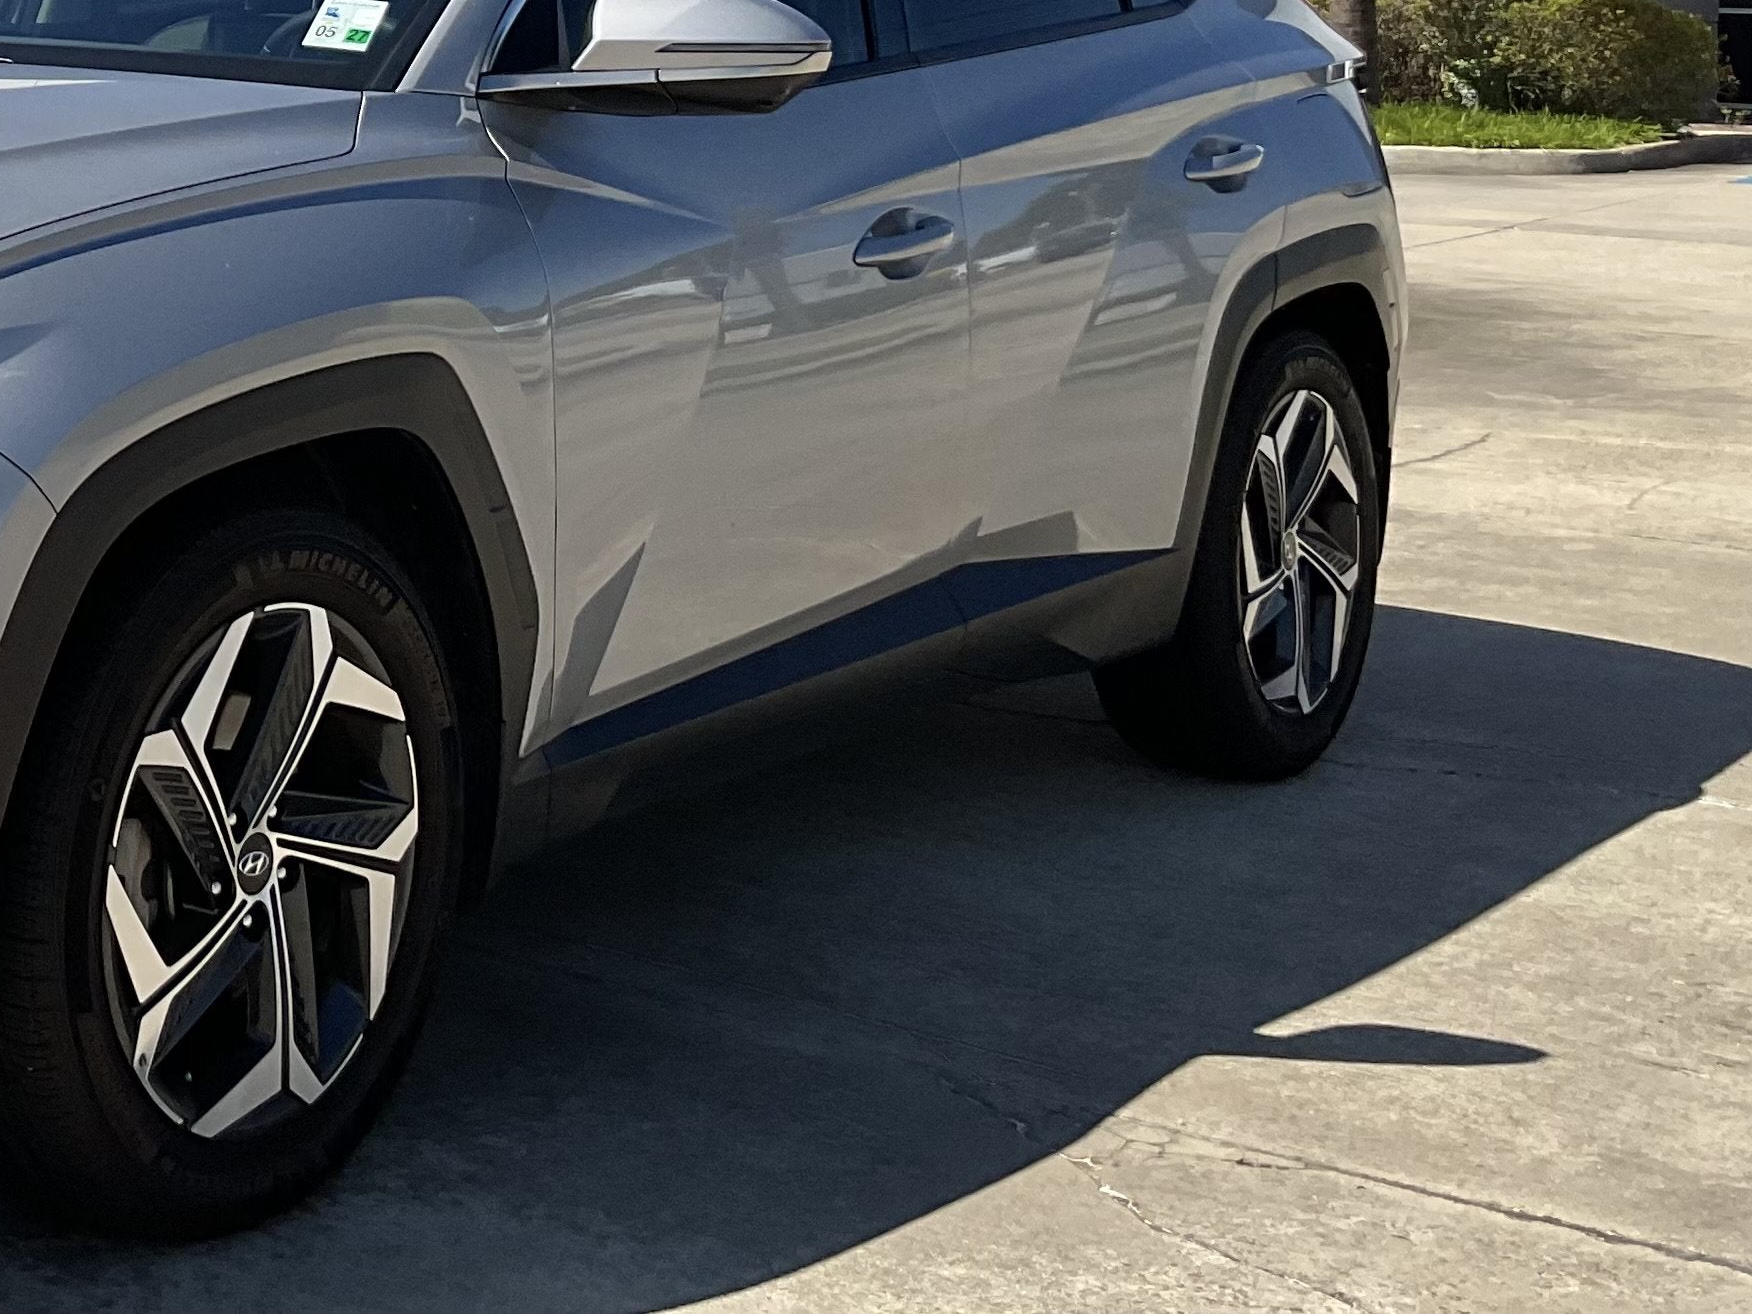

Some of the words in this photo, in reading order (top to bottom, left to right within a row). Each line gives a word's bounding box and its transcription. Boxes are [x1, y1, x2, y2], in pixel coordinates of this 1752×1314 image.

[315, 25, 338, 38] 05
[346, 29, 372, 42] 27
[288, 550, 394, 610] MICHELIN
